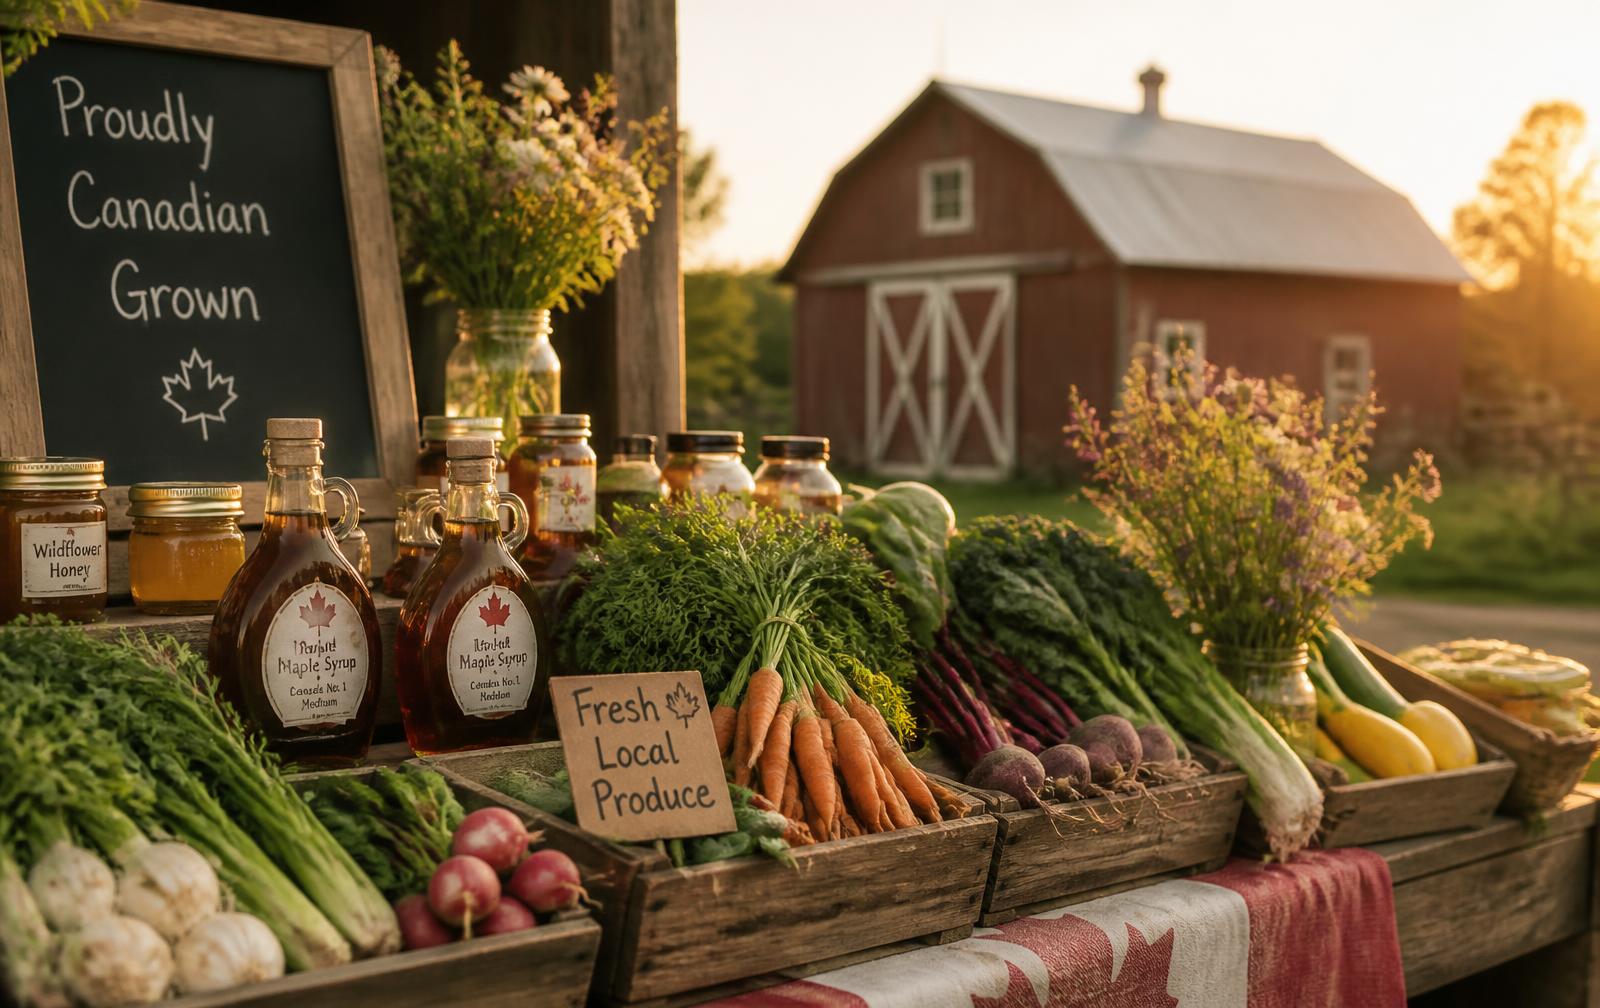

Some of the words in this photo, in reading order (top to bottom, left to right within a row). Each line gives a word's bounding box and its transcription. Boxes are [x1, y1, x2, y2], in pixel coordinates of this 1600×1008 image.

[52, 75, 214, 171] Proudly
[67, 170, 270, 236] Canadian
[110, 259, 260, 322] Grown
[49, 562, 91, 583] Honey
[278, 656, 320, 679] Maple
[324, 655, 357, 677] Syrup
[572, 686, 660, 727] Fresh
[595, 730, 680, 771] Local
[591, 776, 716, 821] Produce
